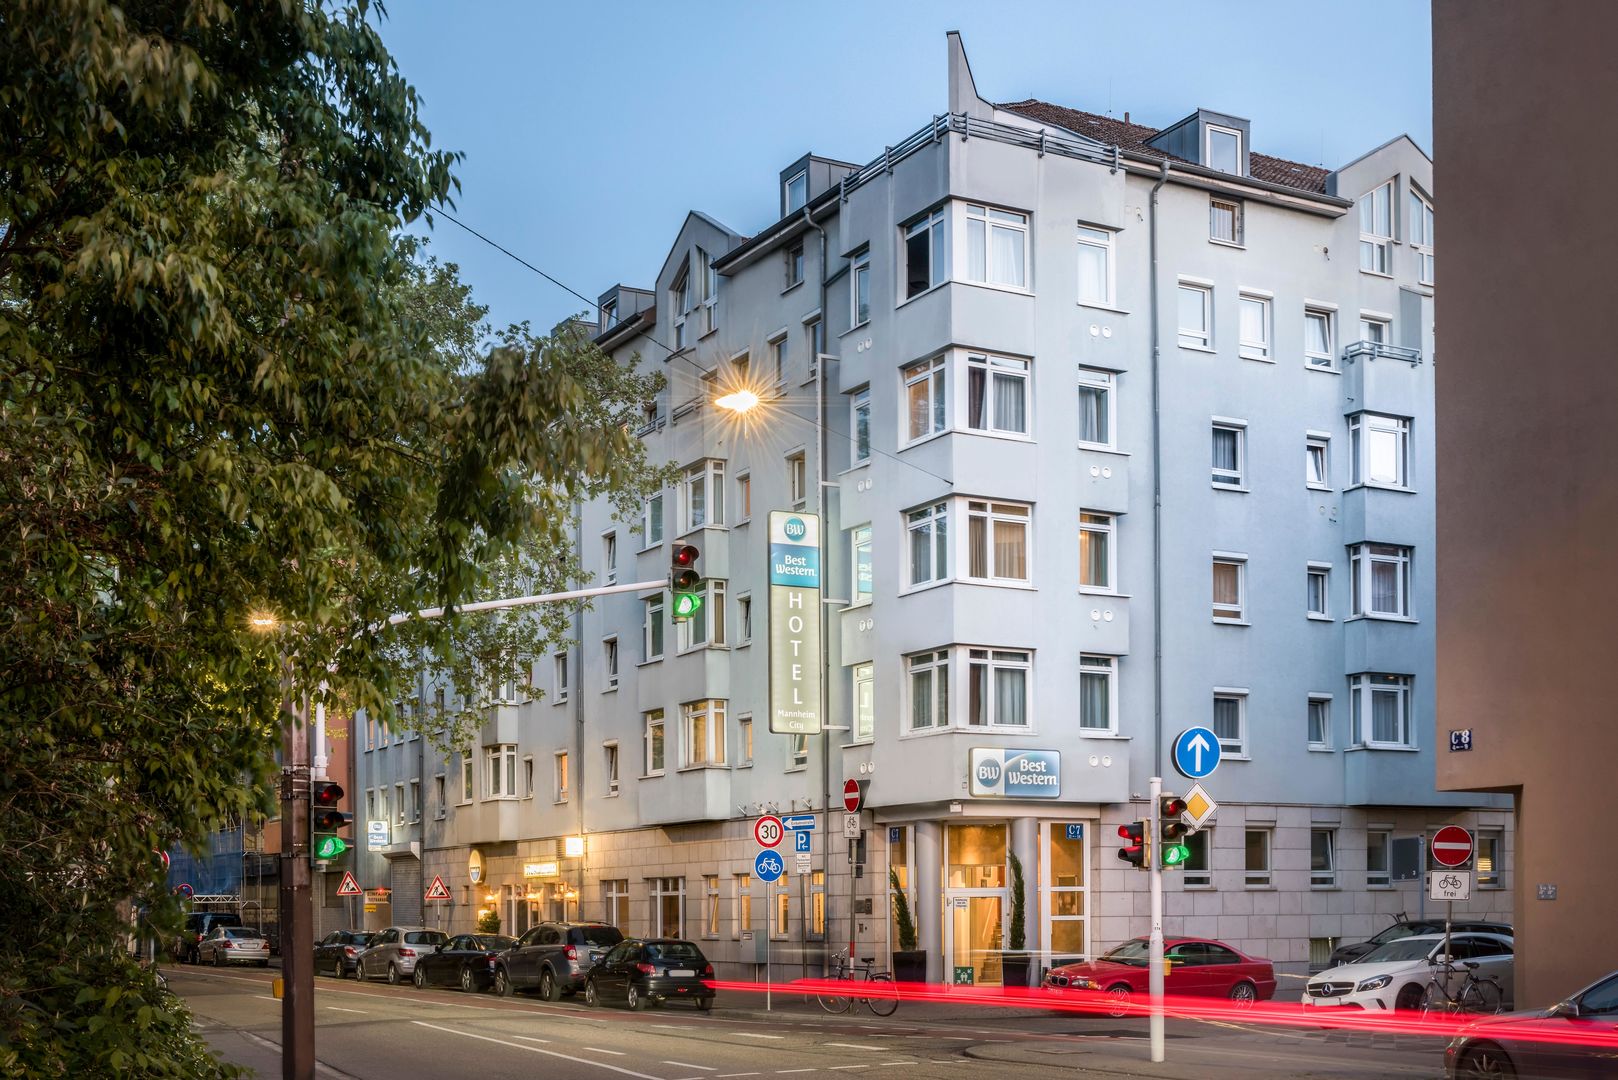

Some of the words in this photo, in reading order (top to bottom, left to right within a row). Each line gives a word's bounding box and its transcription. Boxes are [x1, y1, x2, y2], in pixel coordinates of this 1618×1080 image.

[786, 523, 804, 536] BW
[784, 554, 807, 566] Best
[775, 563, 815, 577] Western
[788, 591, 803, 705] HOTEL
[777, 709, 816, 719] Mannheim
[789, 720, 804, 731] City
[1020, 760, 1047, 772] Best
[979, 766, 1000, 780] BW
[1008, 771, 1057, 786] Western
[761, 825, 778, 839] 30
[797, 833, 806, 850] P
[1443, 890, 1457, 898] frei
